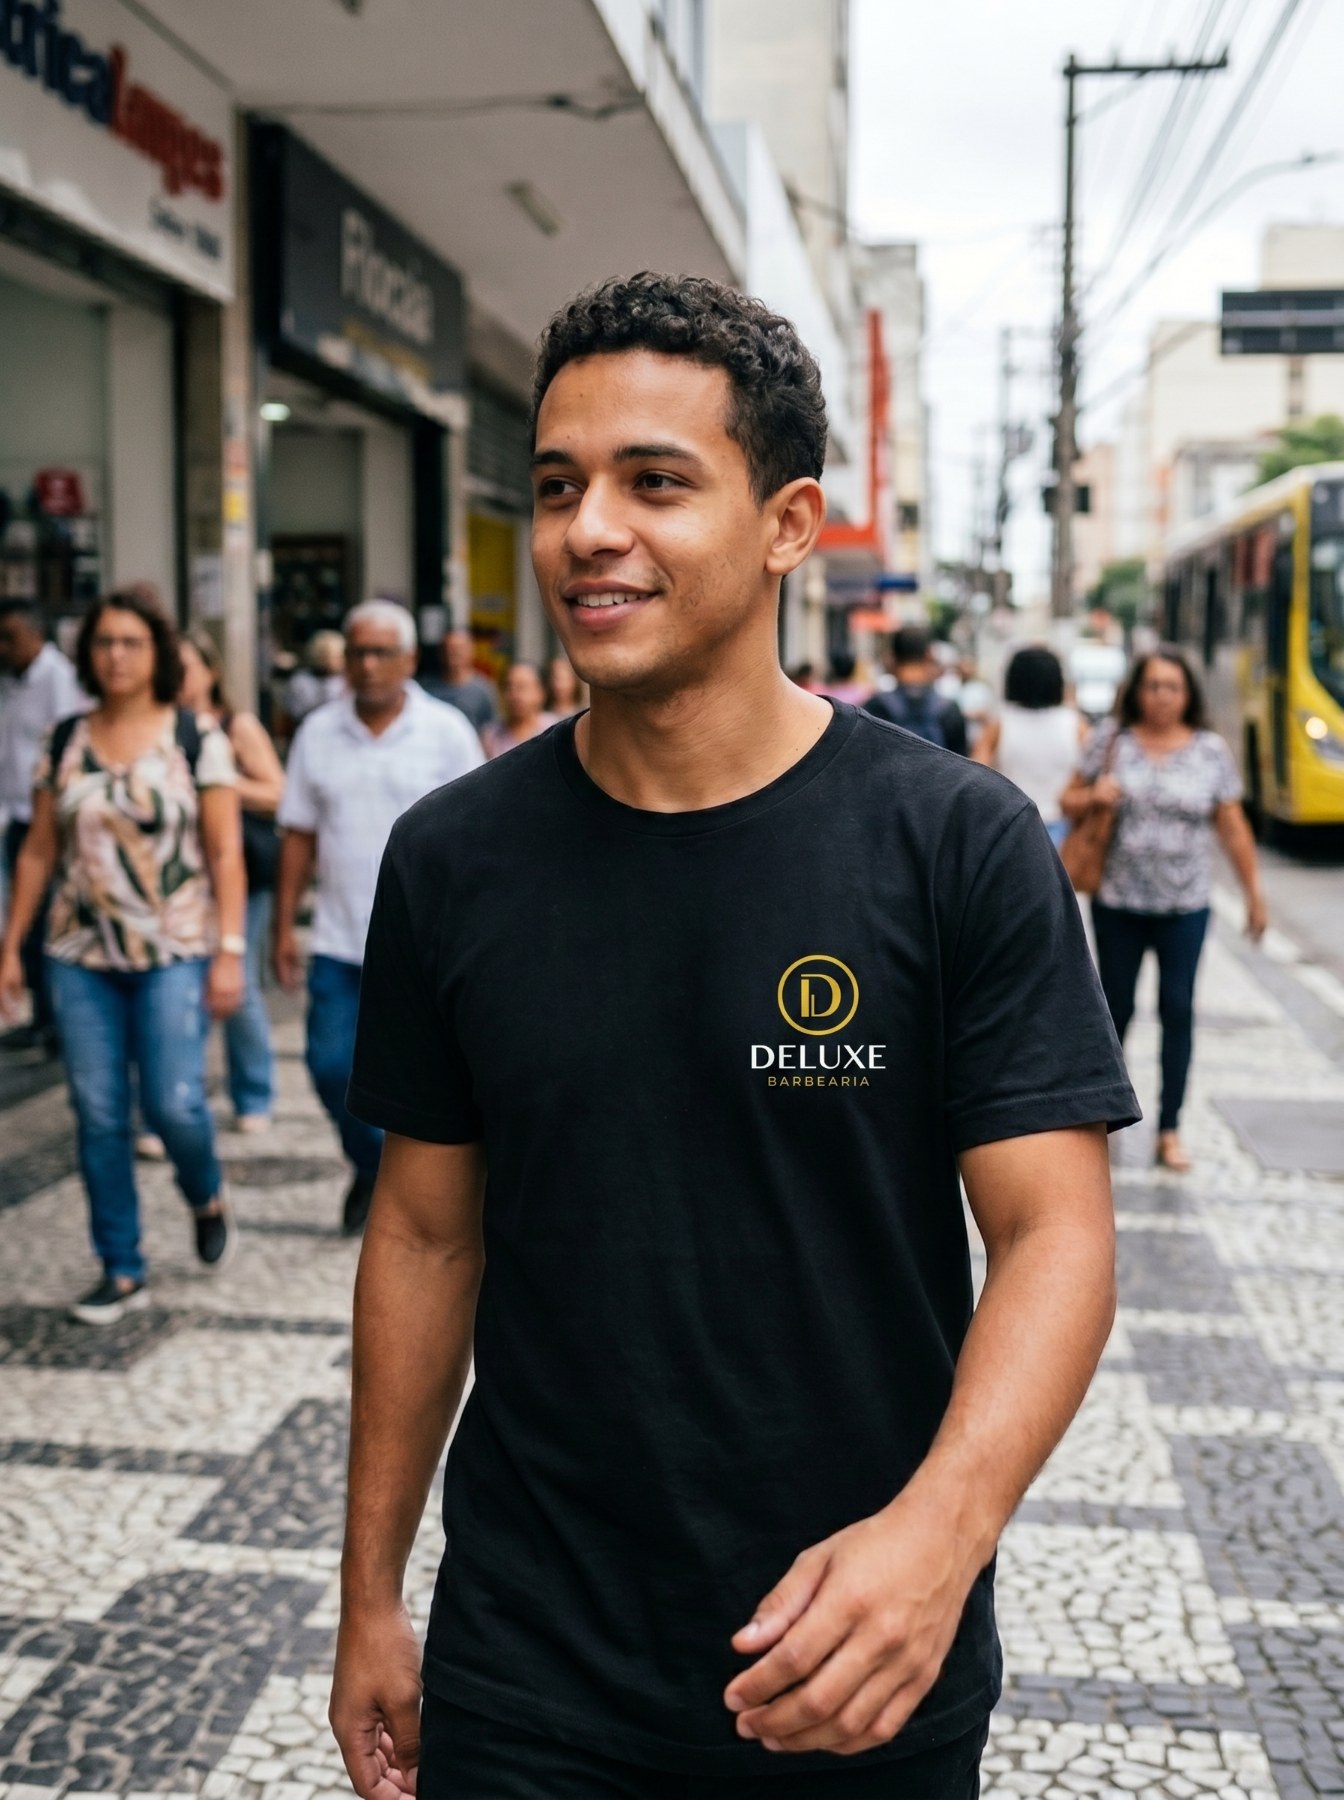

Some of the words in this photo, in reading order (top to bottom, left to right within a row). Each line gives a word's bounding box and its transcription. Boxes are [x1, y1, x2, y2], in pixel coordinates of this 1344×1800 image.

[800, 973, 842, 1018] D
[750, 1044, 887, 1070] DELUXE
[767, 1076, 870, 1087] BARBEARIA
